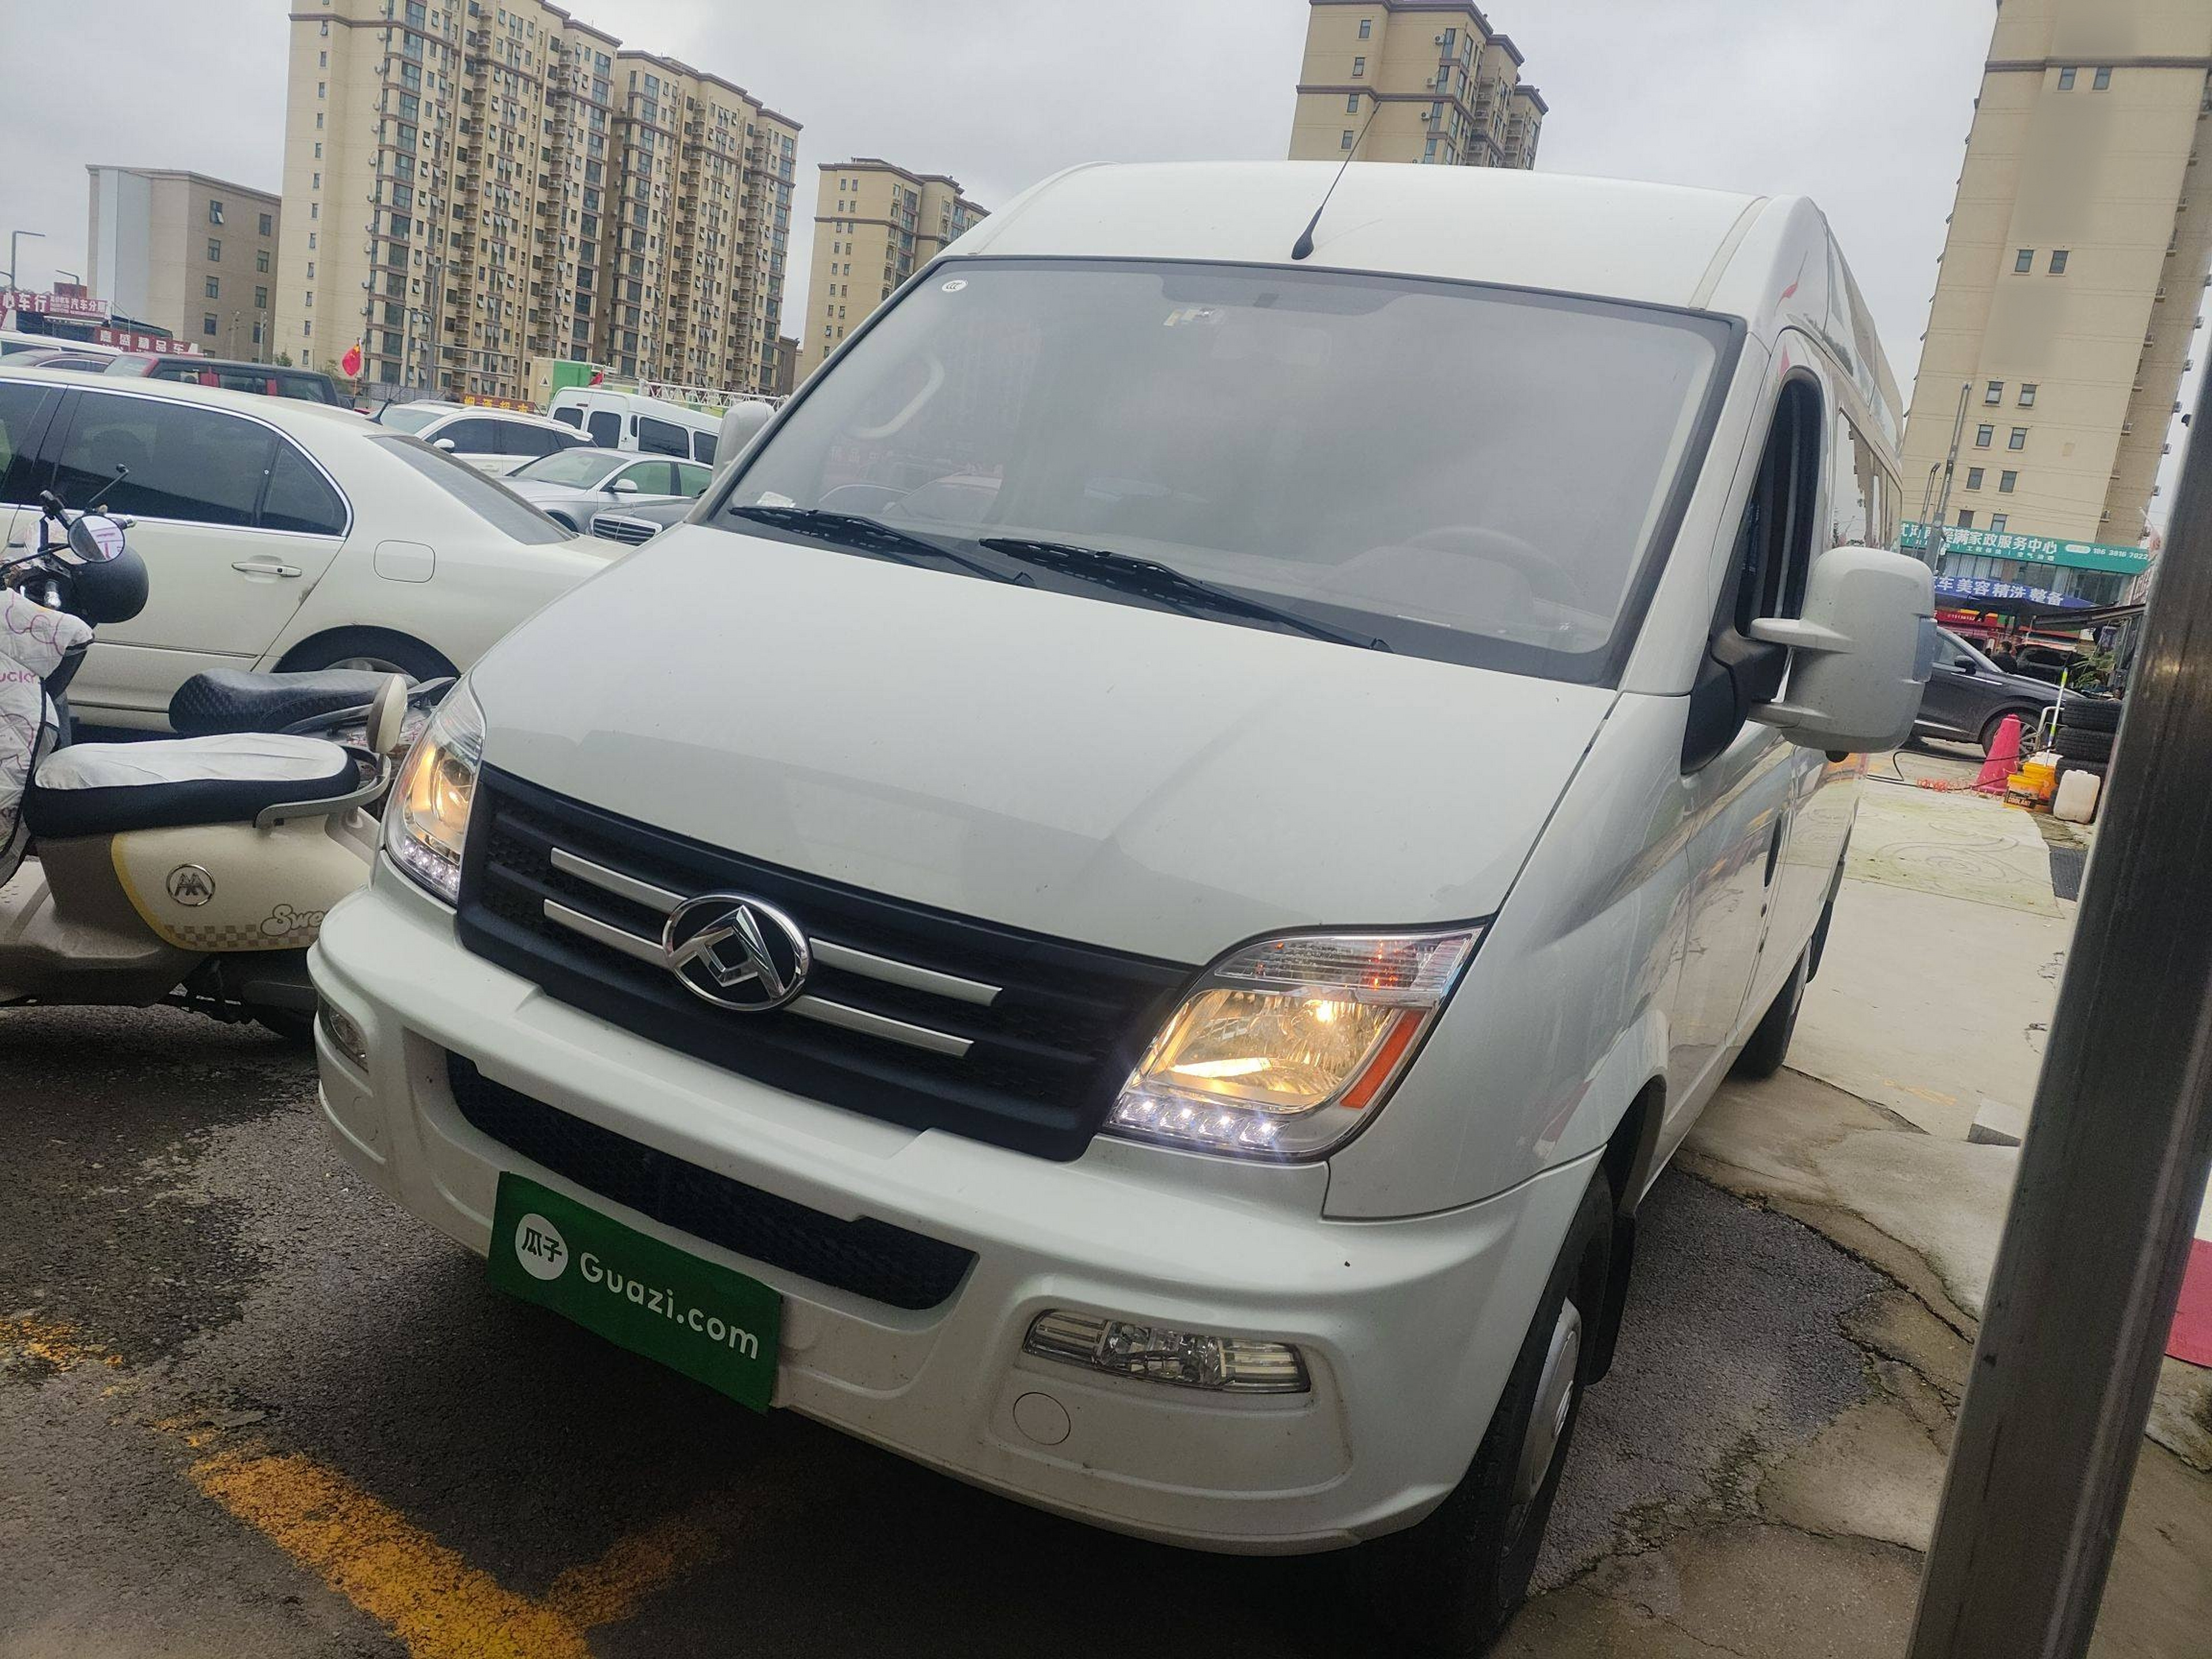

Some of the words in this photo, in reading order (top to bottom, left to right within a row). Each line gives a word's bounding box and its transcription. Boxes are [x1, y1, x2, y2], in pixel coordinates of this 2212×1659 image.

[260, 904, 330, 936] Swe
[521, 1227, 562, 1262] 瓜子
[580, 1252, 759, 1360] Guazi.com
